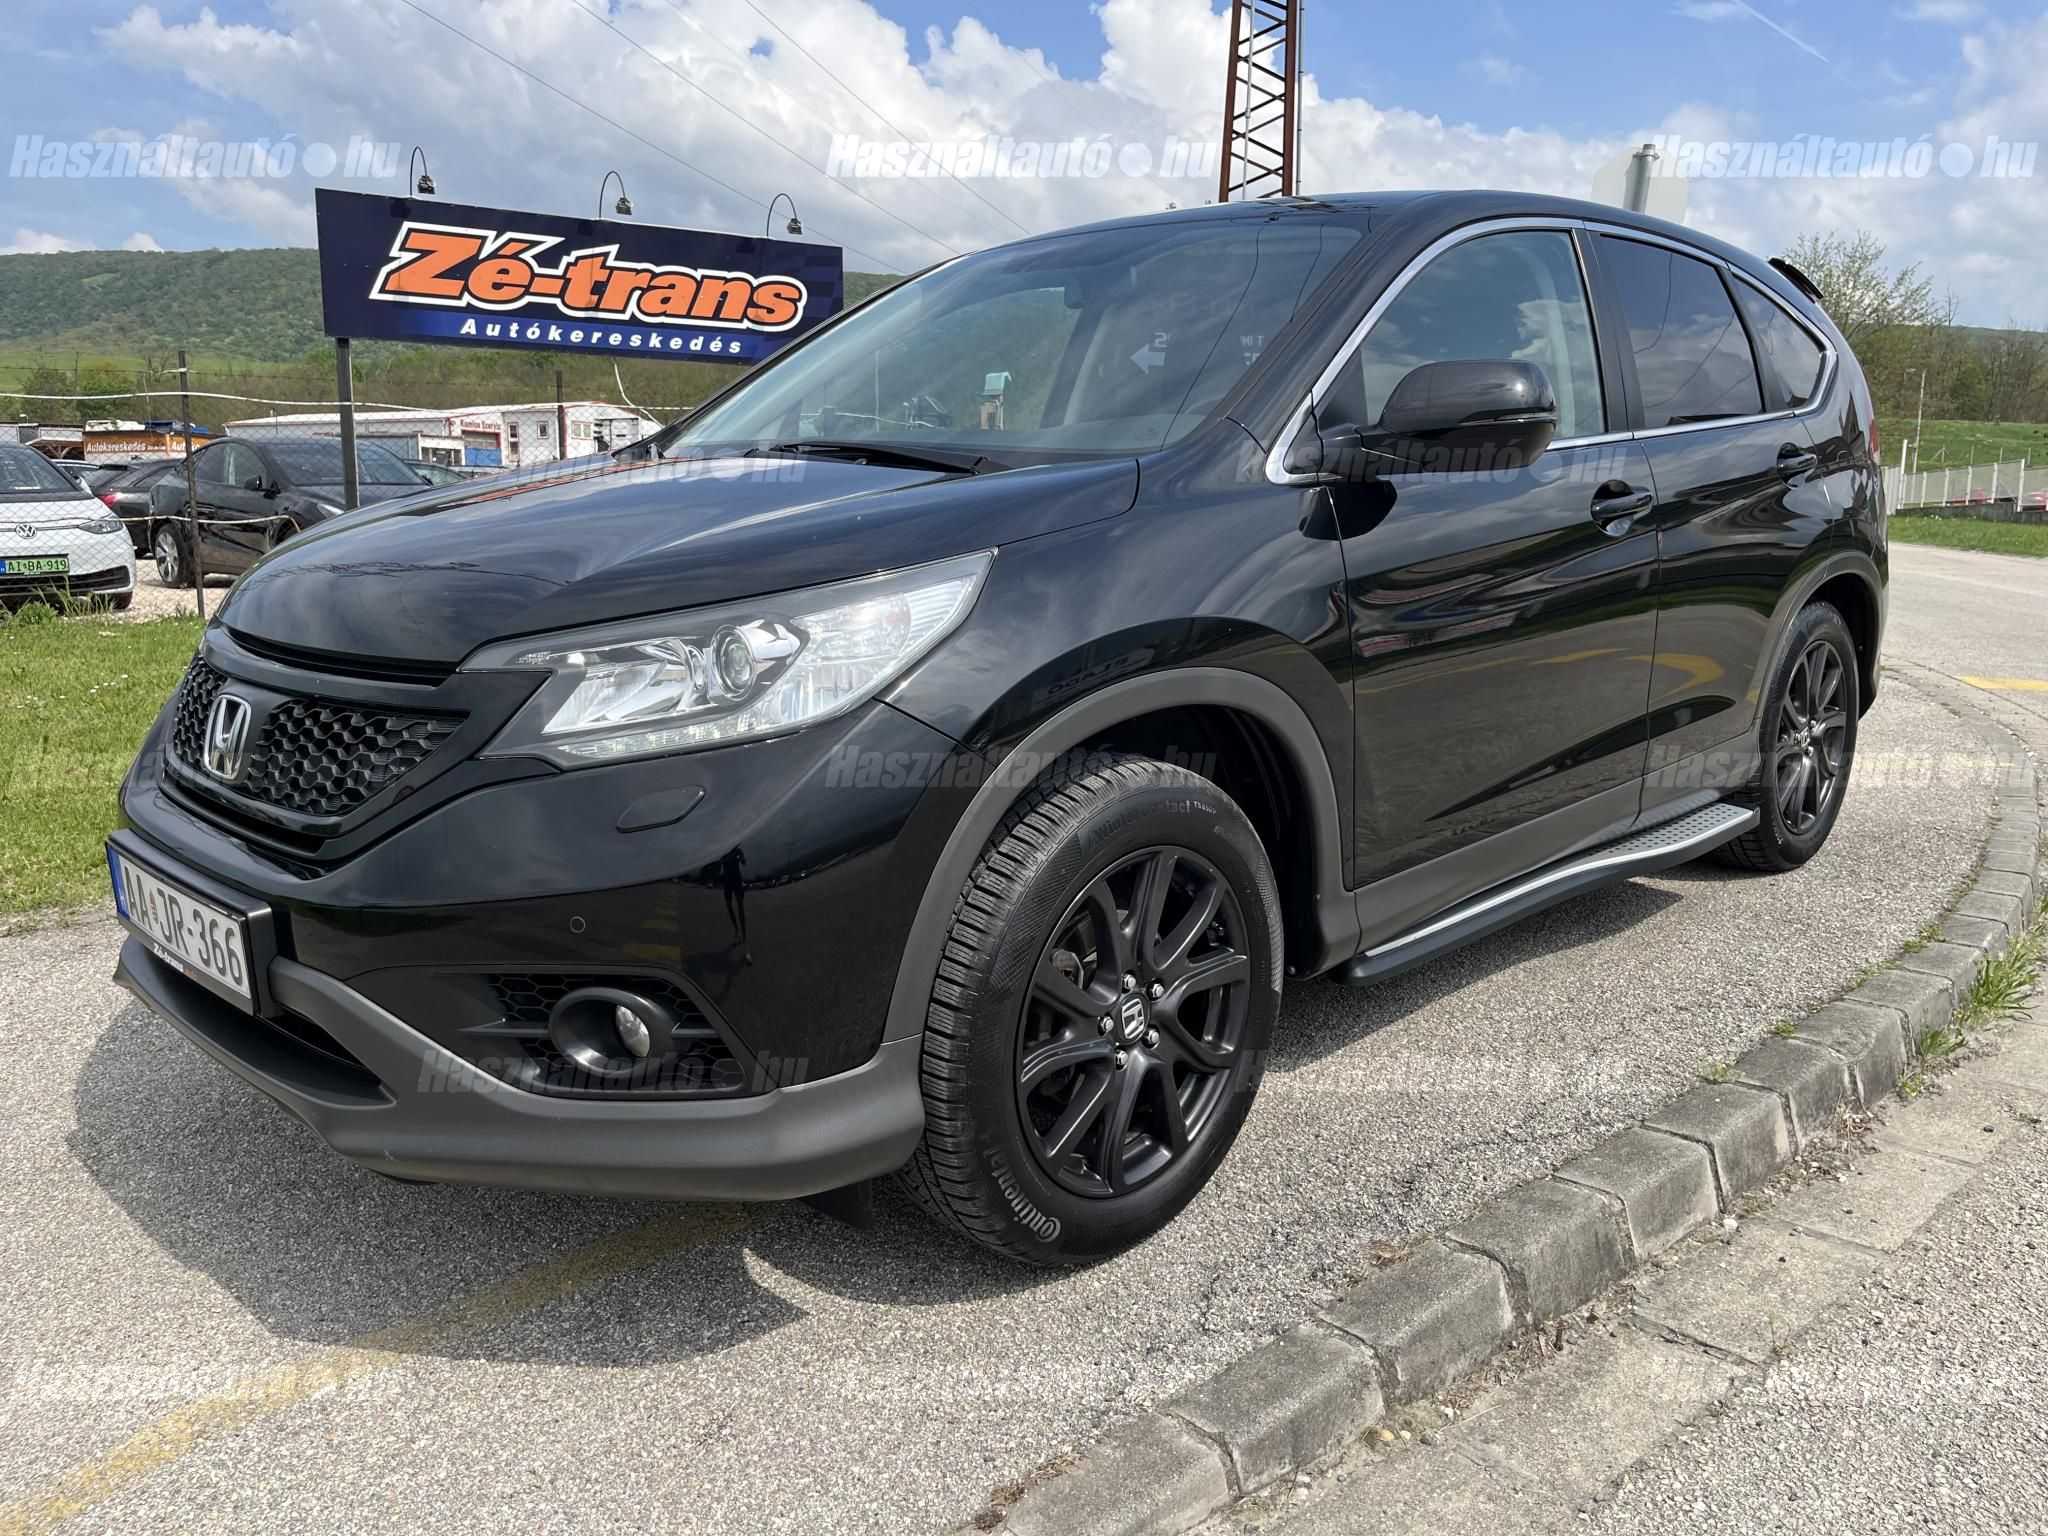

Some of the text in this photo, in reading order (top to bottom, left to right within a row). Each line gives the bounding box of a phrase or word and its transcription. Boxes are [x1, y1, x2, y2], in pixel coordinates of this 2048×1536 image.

[378, 226, 806, 329] Zé-trans
[460, 318, 743, 355] Autókereskedés
[460, 420, 481, 429] Kamion
